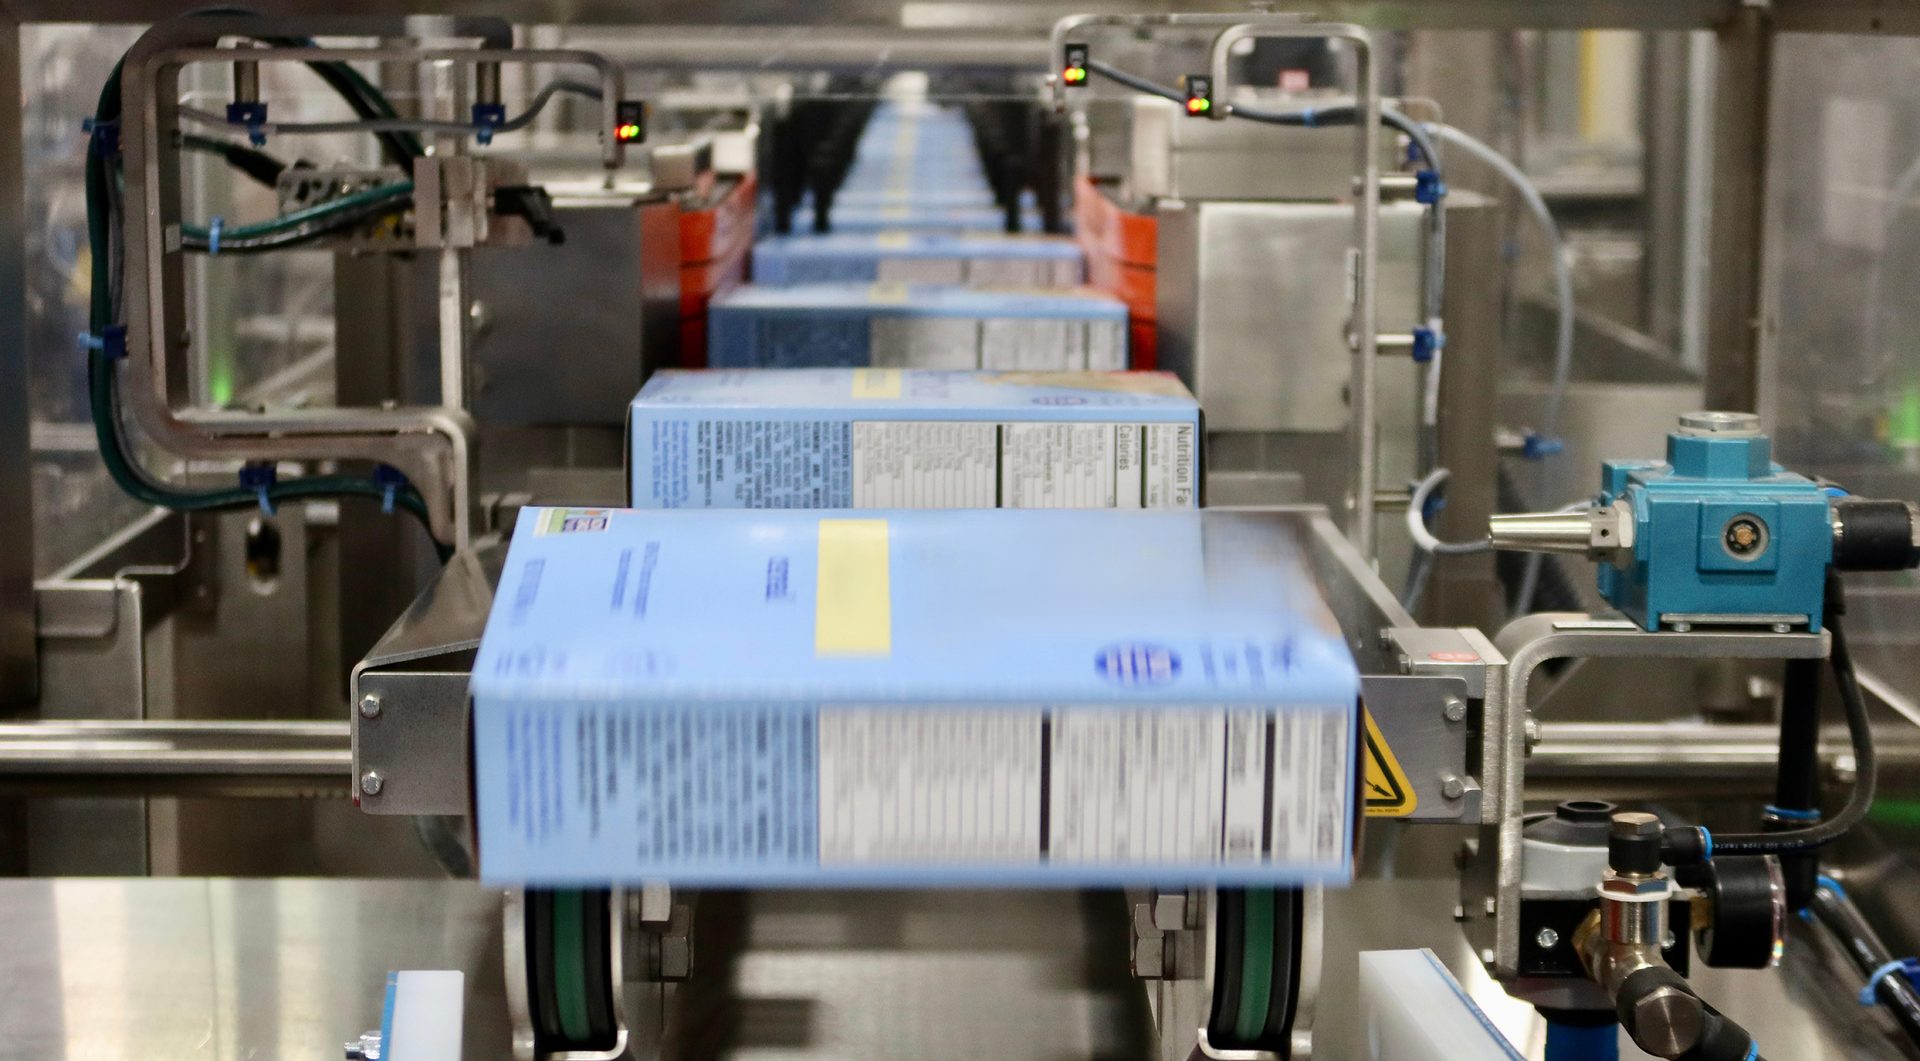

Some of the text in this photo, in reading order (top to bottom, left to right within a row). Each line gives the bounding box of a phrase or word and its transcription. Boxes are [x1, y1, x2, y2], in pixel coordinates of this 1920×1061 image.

[1120, 425, 1132, 471] Calories
[1176, 426, 1191, 504] Nutrition Fa
